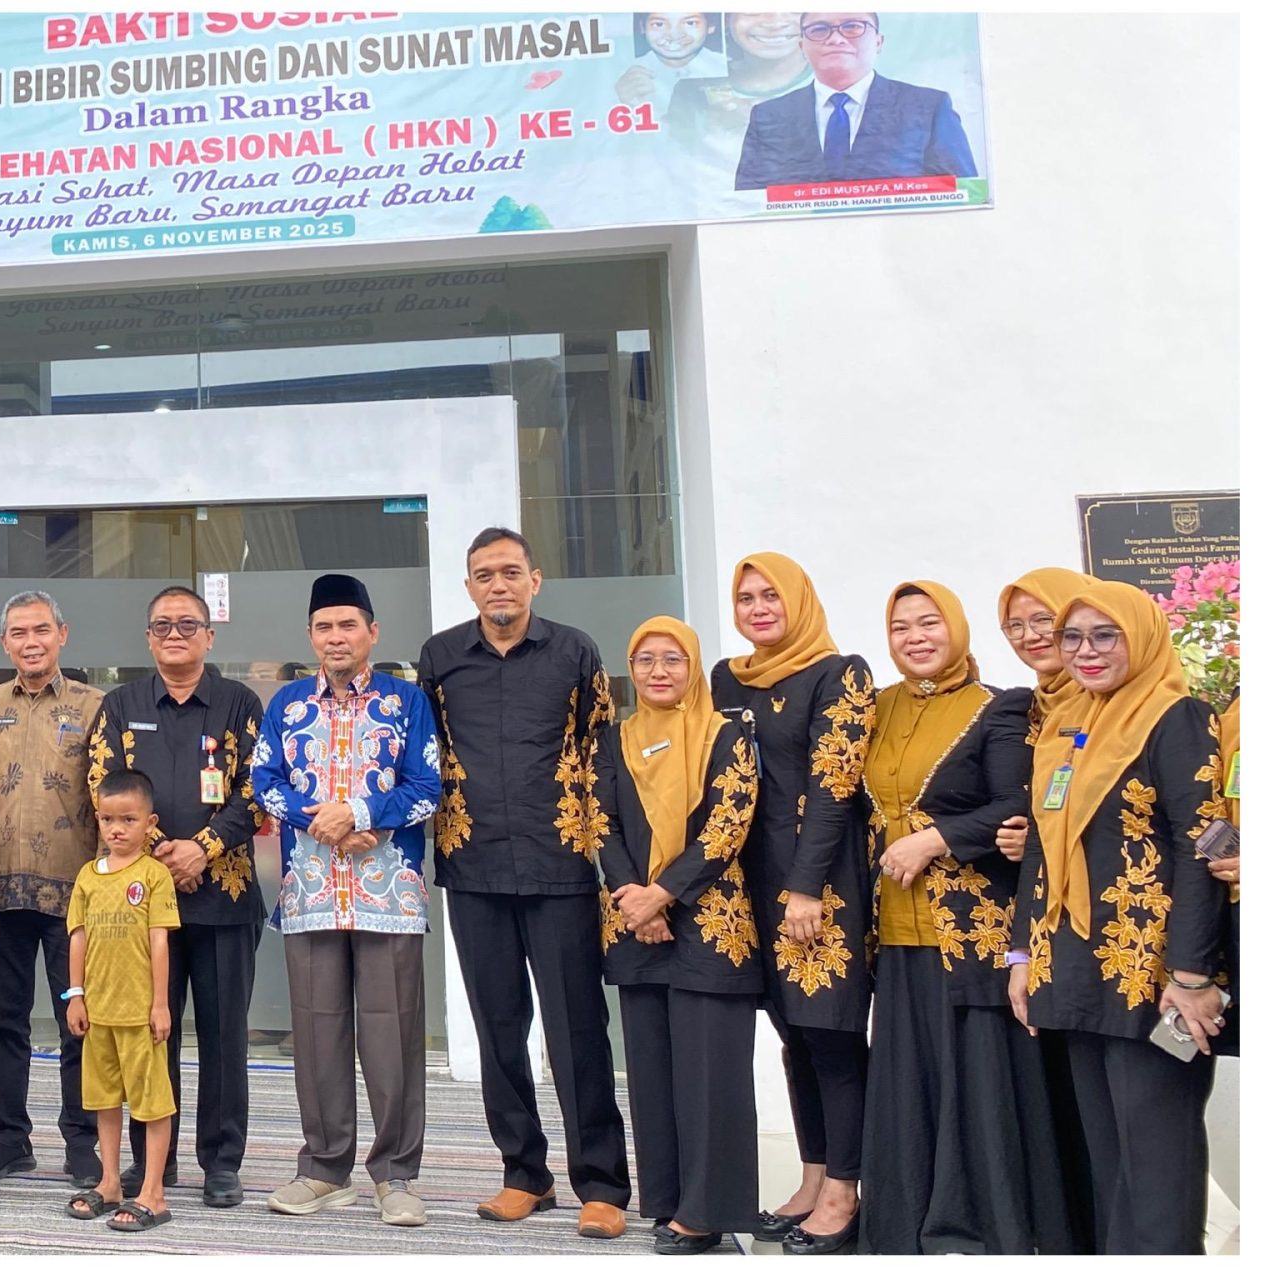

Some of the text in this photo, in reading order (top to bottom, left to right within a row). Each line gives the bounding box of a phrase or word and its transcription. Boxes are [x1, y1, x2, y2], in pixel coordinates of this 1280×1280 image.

[47, 12, 189, 50] BAKTI
[13, 64, 102, 104] BIBIR
[110, 47, 267, 95] SUMBING
[278, 40, 348, 81] DAN
[359, 31, 474, 74] SUNAT
[484, 18, 610, 63] MASAL
[83, 85, 370, 133] Dalam Rangka
[150, 128, 343, 168] NASIONAL
[389, 119, 472, 150] HKN
[520, 110, 572, 140] KE
[608, 103, 659, 133] 61
[52, 175, 155, 204] Sehat,
[173, 169, 280, 194] Masa
[292, 161, 406, 193] Depan
[418, 149, 526, 176] Hebat
[812, 187, 831, 196] EDI
[85, 204, 178, 228] Baru,
[192, 188, 371, 221] Semangat
[381, 184, 475, 208] Baru
[766, 201, 811, 210] DIREKTUR
[813, 200, 839, 208] RSUD
[852, 197, 891, 206] HANAFIE
[894, 195, 928, 204] MUARA
[929, 193, 964, 202] BUNGO
[63, 221, 344, 253] KAMIS, 6 NOVEMBER 2025
[1102, 555, 1230, 566] Rumah Sakit Umum Daerah
[1131, 544, 1240, 555] Gedung Instalasi Farma
